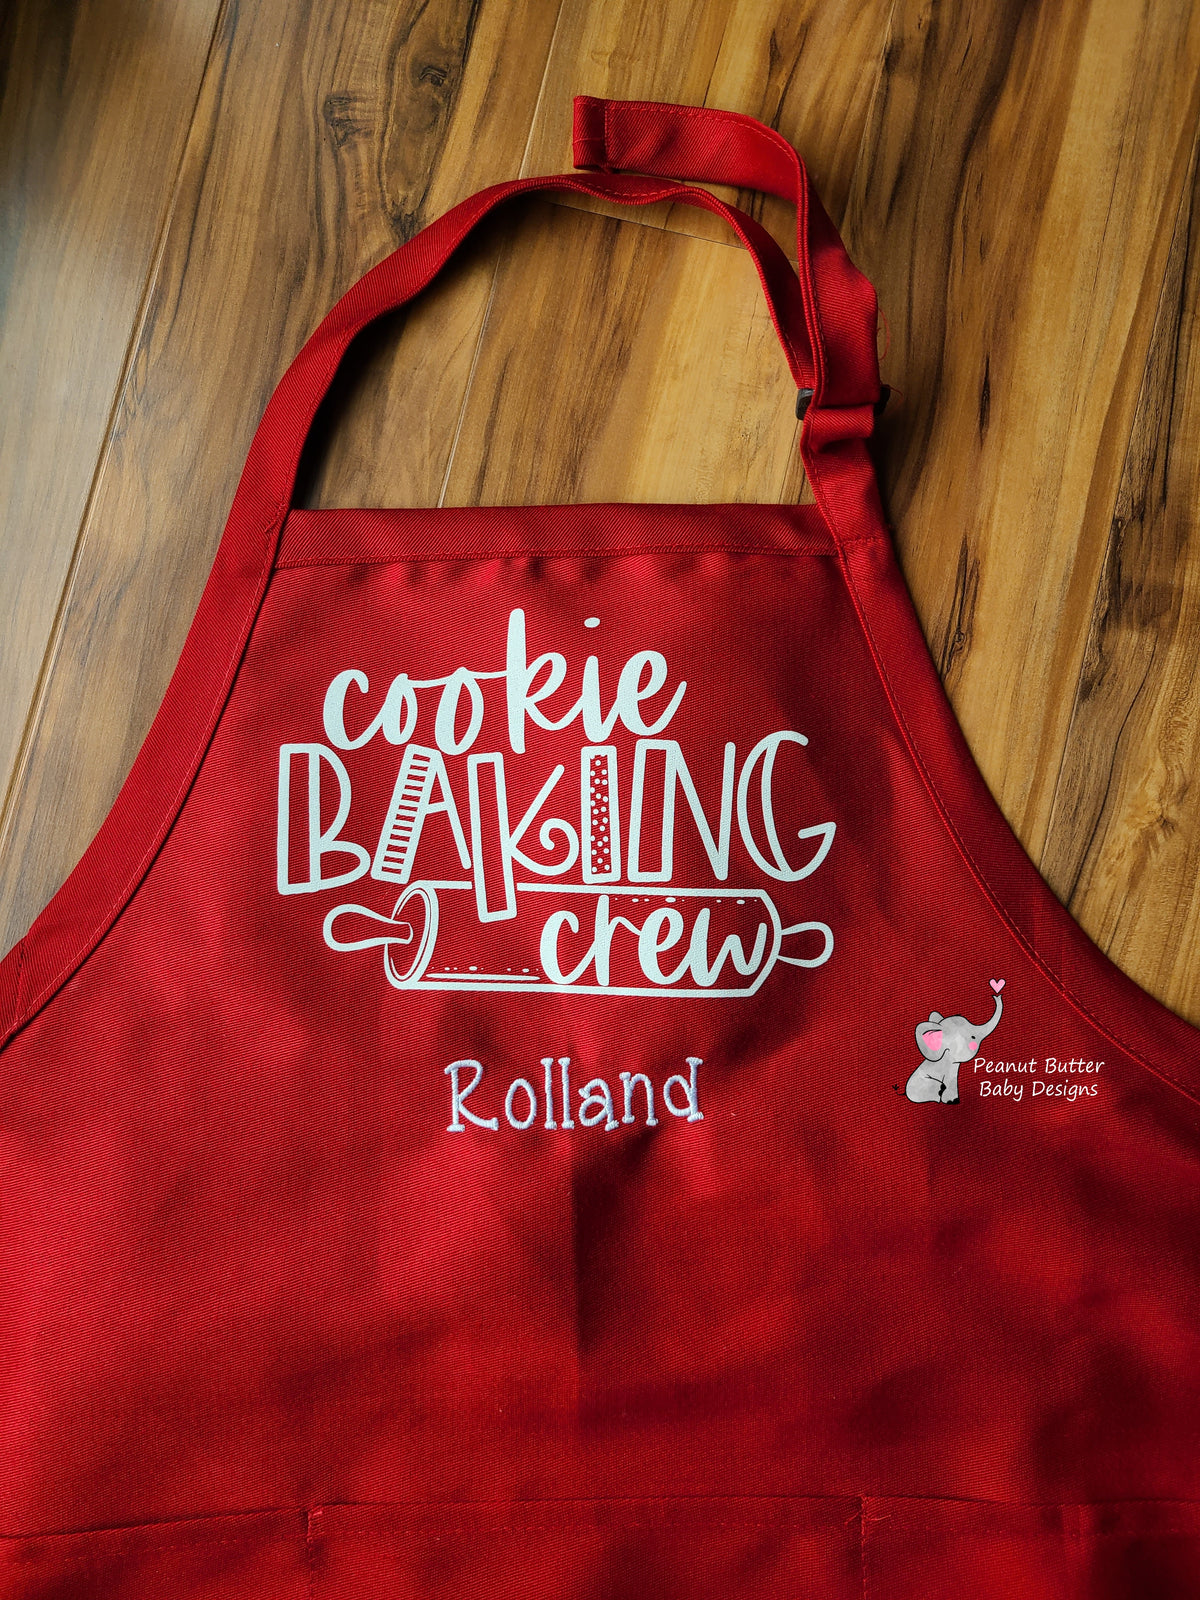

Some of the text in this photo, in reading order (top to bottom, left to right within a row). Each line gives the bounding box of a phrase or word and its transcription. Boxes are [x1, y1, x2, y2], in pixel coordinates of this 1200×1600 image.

[323, 608, 688, 755] cookie
[276, 730, 837, 923] BAKING
[539, 894, 767, 987] crew
[443, 1057, 705, 1132] Rolland
